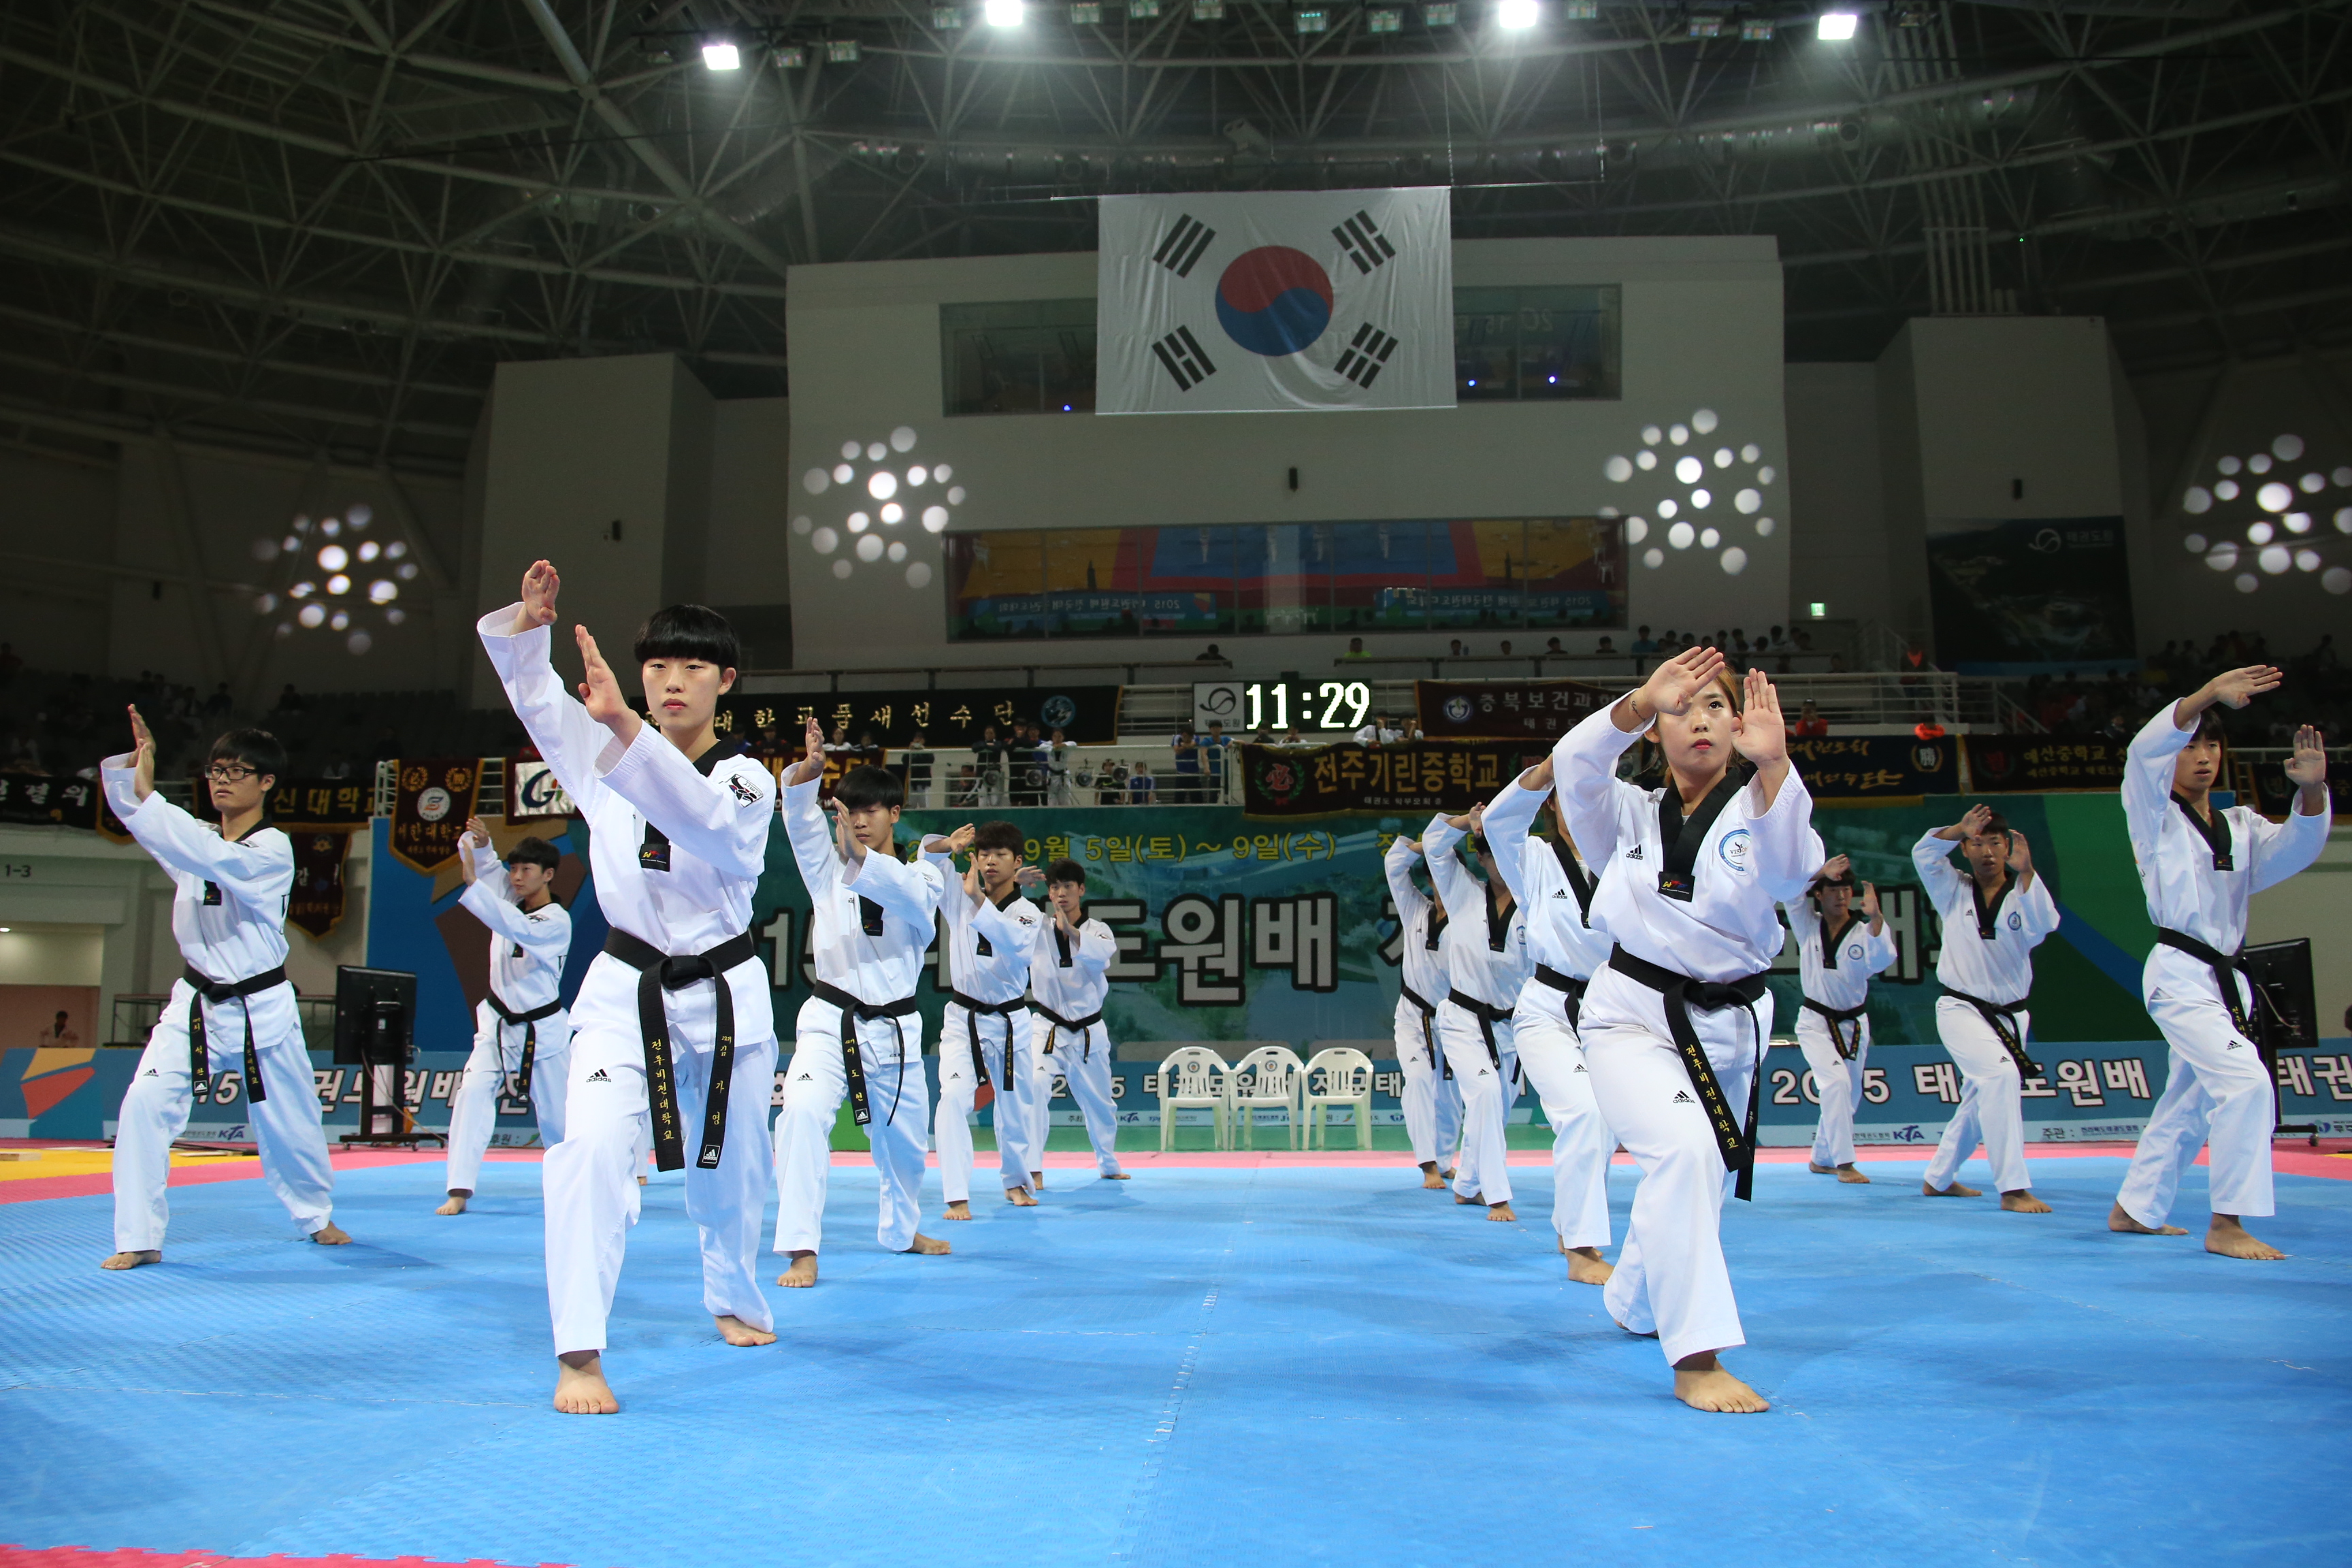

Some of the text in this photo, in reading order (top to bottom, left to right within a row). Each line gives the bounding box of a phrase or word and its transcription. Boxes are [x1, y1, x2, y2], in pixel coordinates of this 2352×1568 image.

[1245, 682, 1371, 730] 11:29
[1313, 750, 1500, 794] 전주기린중학교
[1024, 836, 1070, 862] 9월
[1086, 834, 1187, 864] 5일(토)
[1232, 832, 1336, 862] 9일(수)
[5, 864, 31, 878] 1-3
[651, 1039, 675, 1141] 전주비전대학교
[1685, 1044, 1740, 1150] 전주비전대학교
[1771, 1069, 1891, 1105] 205
[218, 1124, 247, 1141] KTA
[1120, 1112, 1140, 1123] KTA
[1893, 1125, 1925, 1142] KTA
[2042, 1127, 2065, 1139] 주관
